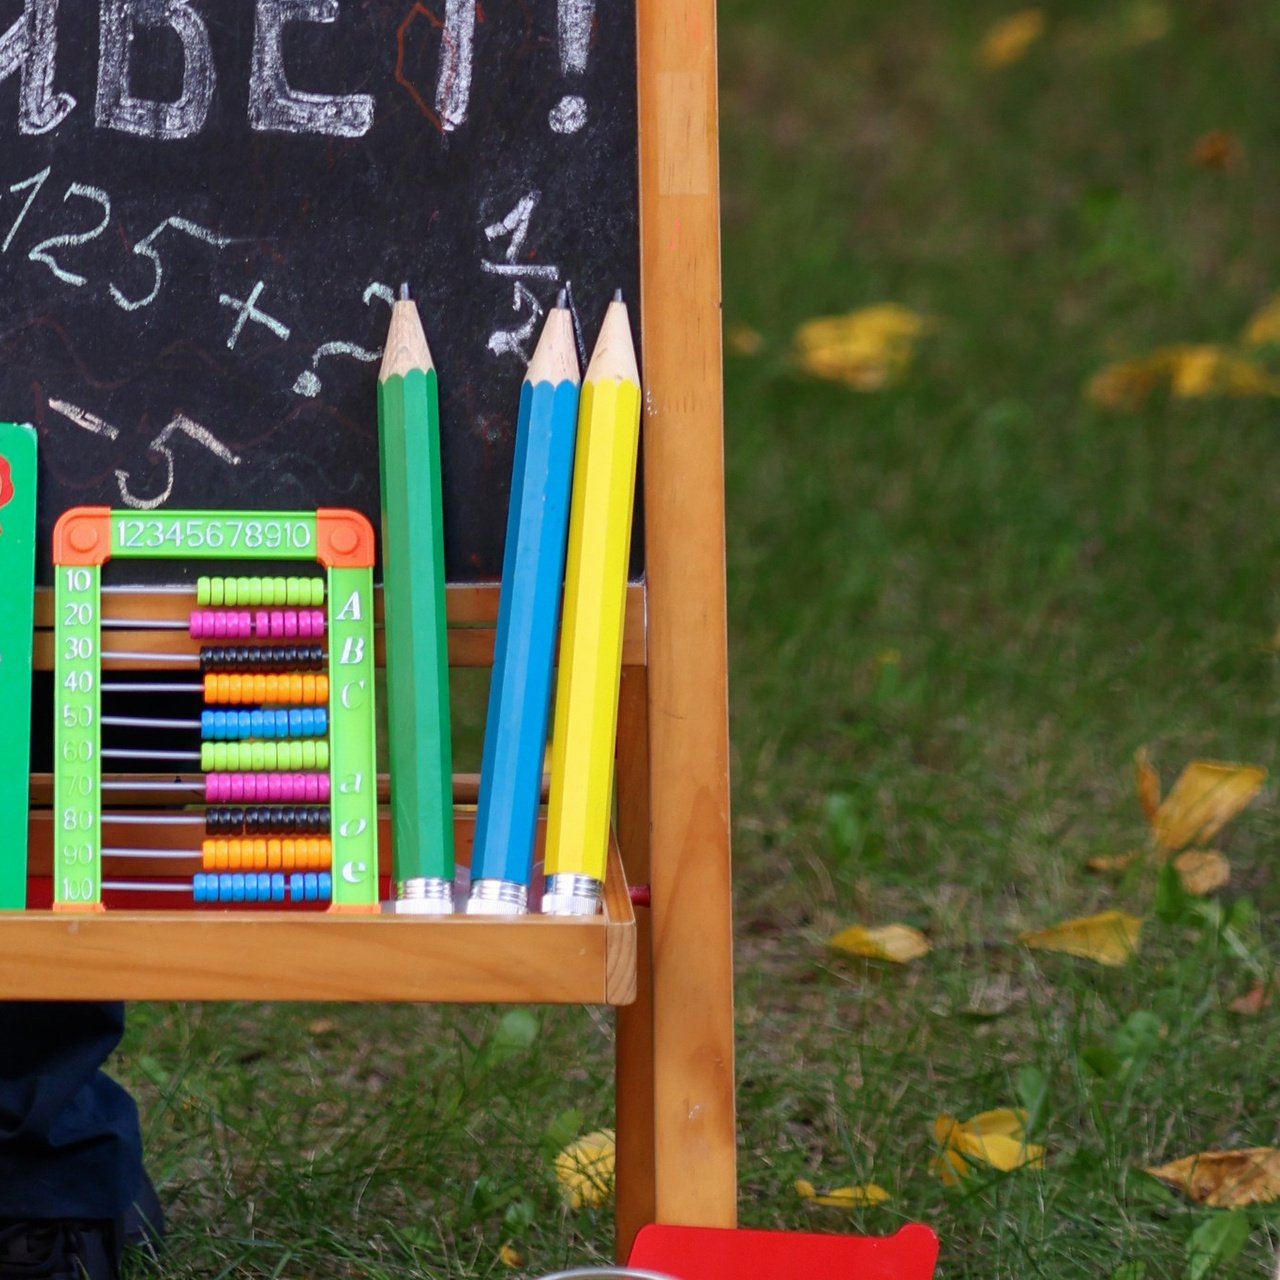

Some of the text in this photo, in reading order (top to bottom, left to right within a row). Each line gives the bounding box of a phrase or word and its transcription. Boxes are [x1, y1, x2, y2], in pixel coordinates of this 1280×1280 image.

[66, 569, 92, 592] 10
[64, 601, 93, 626] 20
[335, 590, 363, 621] A
[64, 636, 93, 660] 30
[340, 636, 365, 665] B
[64, 670, 93, 694] 40
[341, 679, 365, 710] C
[64, 704, 93, 728] 50
[63, 739, 93, 762] 60
[64, 773, 93, 797] 70
[63, 807, 93, 831] 80
[63, 841, 93, 866] 90
[63, 876, 93, 901] 100
